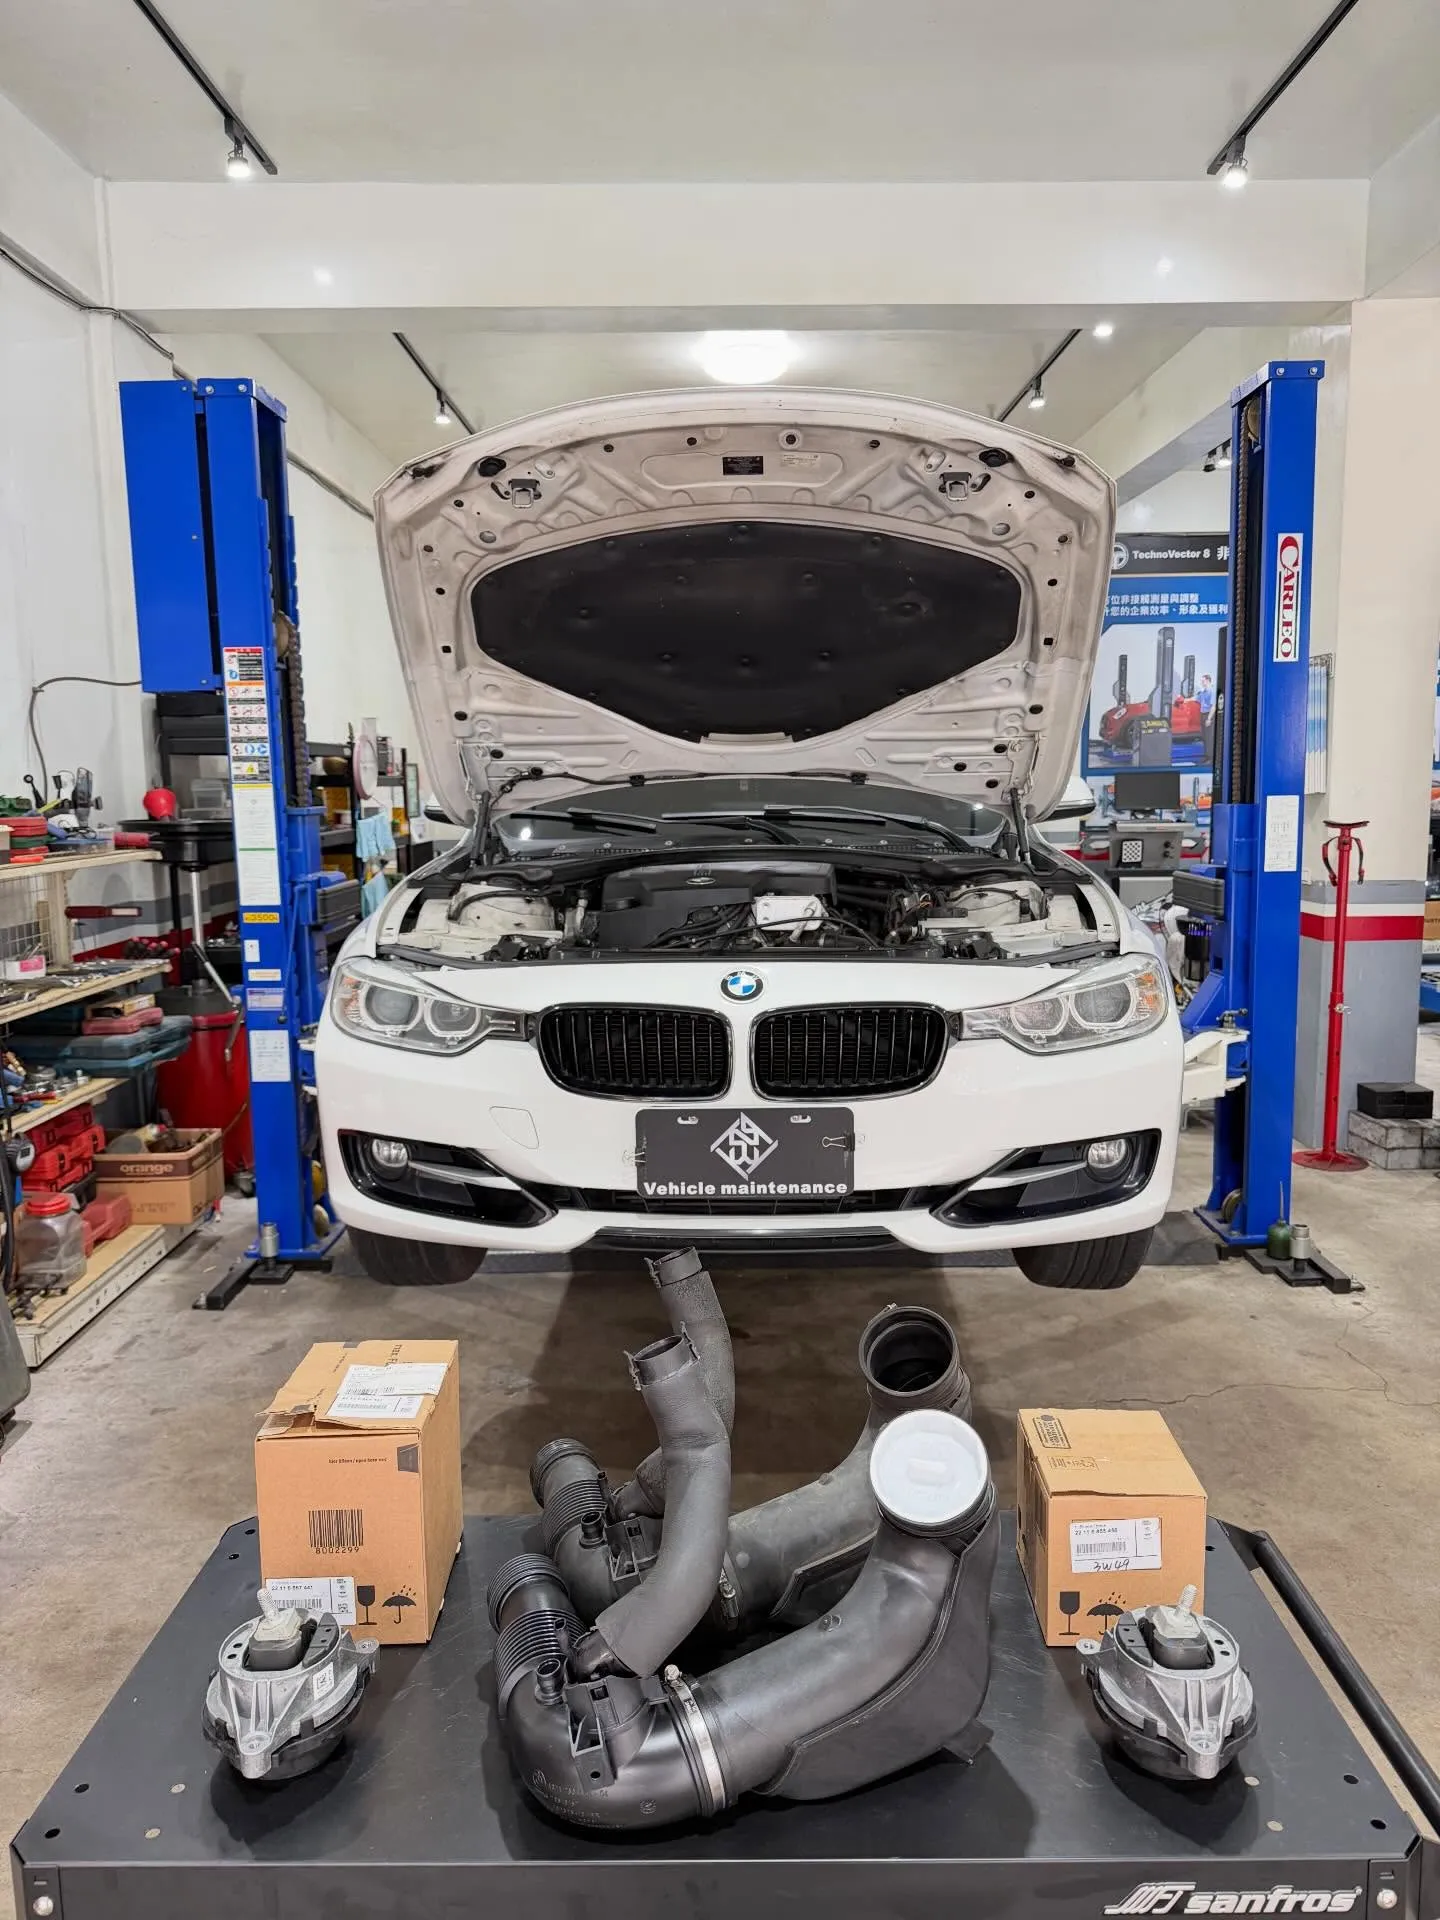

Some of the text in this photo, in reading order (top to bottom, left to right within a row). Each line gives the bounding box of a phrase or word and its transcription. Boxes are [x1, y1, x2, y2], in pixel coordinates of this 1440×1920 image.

[1132, 549, 1201, 559] TechnoVector
[1202, 548, 1211, 558] 8
[1280, 536, 1299, 657] CARLEO
[120, 1163, 174, 1175] orange
[643, 1181, 848, 1196] Vehicle maintenance
[315, 1546, 359, 1554] 8002299
[1184, 1884, 1355, 1913] sanfros
